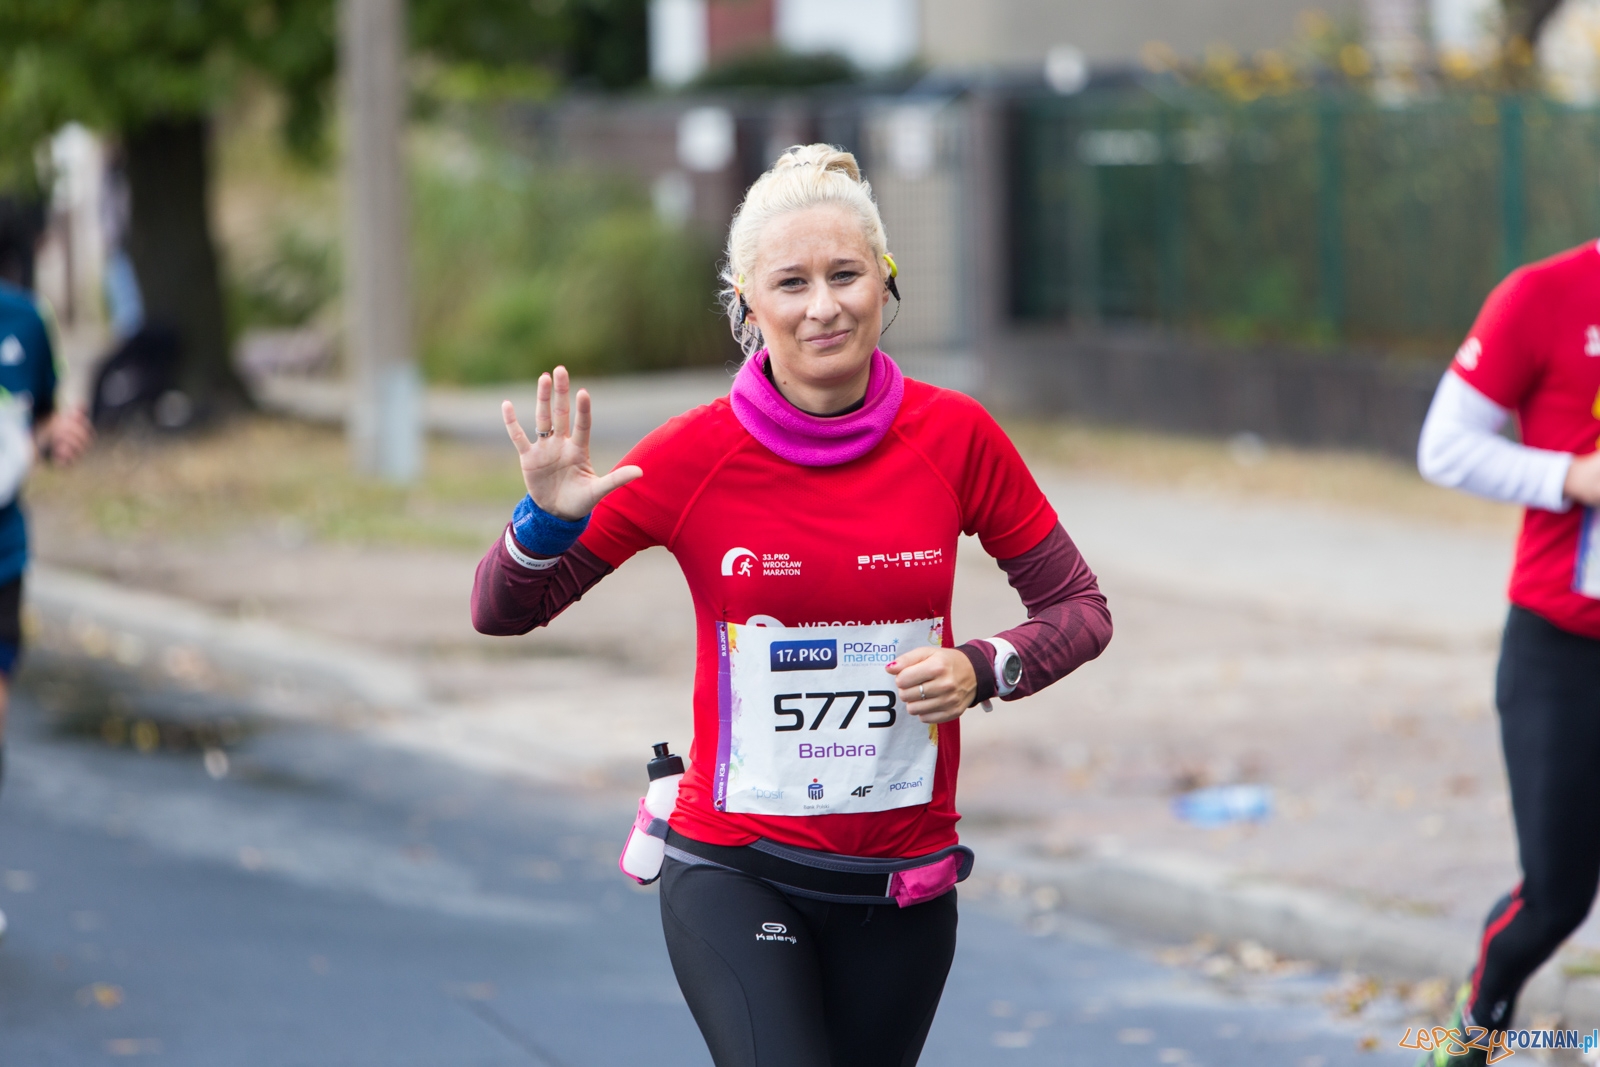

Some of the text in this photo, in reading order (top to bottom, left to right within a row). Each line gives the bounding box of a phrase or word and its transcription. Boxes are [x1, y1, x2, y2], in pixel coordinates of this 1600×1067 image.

[857, 548, 942, 564] BRUBECK
[843, 652, 896, 662] maraton
[774, 690, 897, 732] 5773
[799, 743, 876, 758] Barbara
[851, 785, 874, 797] 4F
[755, 933, 797, 945] Kalenji
